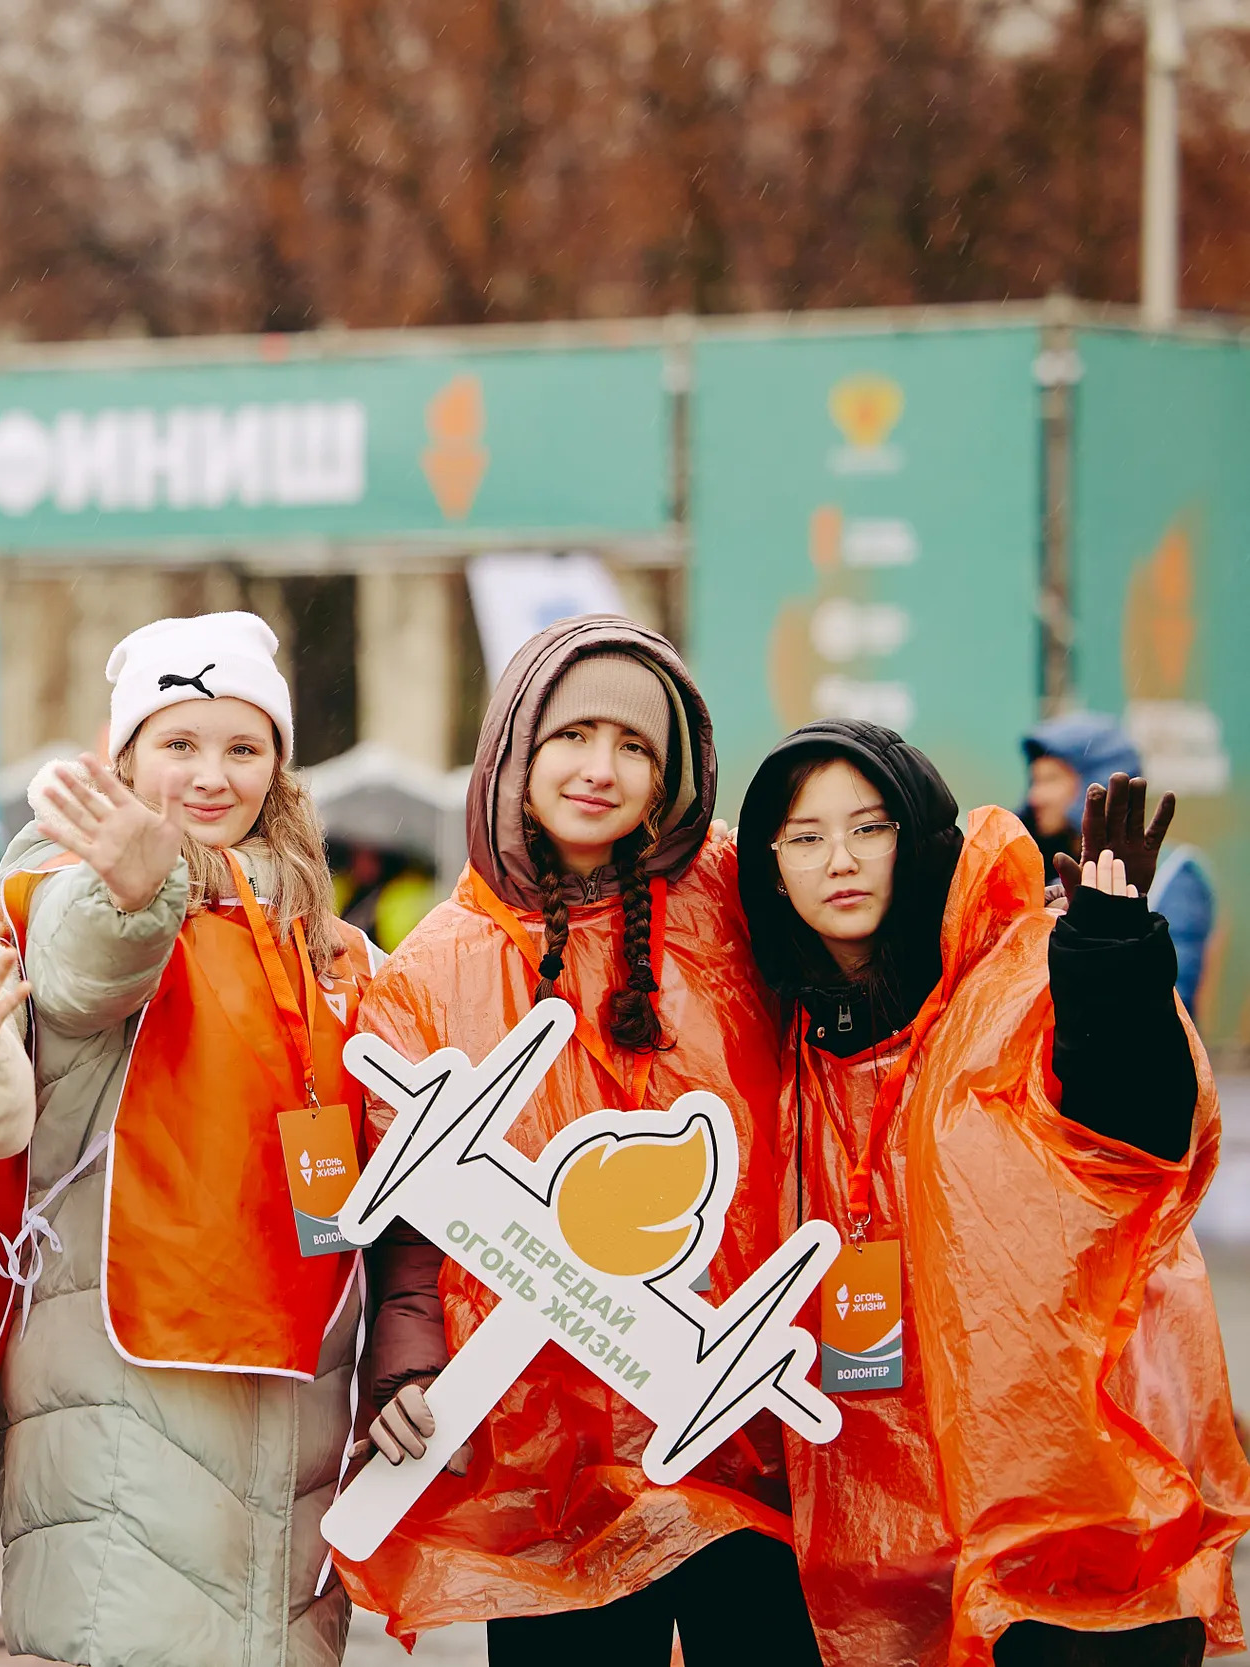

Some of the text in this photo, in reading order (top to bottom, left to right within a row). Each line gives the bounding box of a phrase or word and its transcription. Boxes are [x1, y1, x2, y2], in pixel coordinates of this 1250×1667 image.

[315, 1158, 343, 1168] ОГОНЬ
[316, 1167, 346, 1178] ЖИЗНИ
[313, 1231, 346, 1245] ВОЛОН
[500, 1220, 637, 1336] ПЕРЕДАЙ
[854, 1292, 884, 1303] ОГОНЬ
[445, 1220, 652, 1390] ОГОНЬ ЖИЗНИ
[852, 1301, 886, 1313] ЖИЗНИ
[837, 1366, 890, 1380] ВОЛОНТЕР
